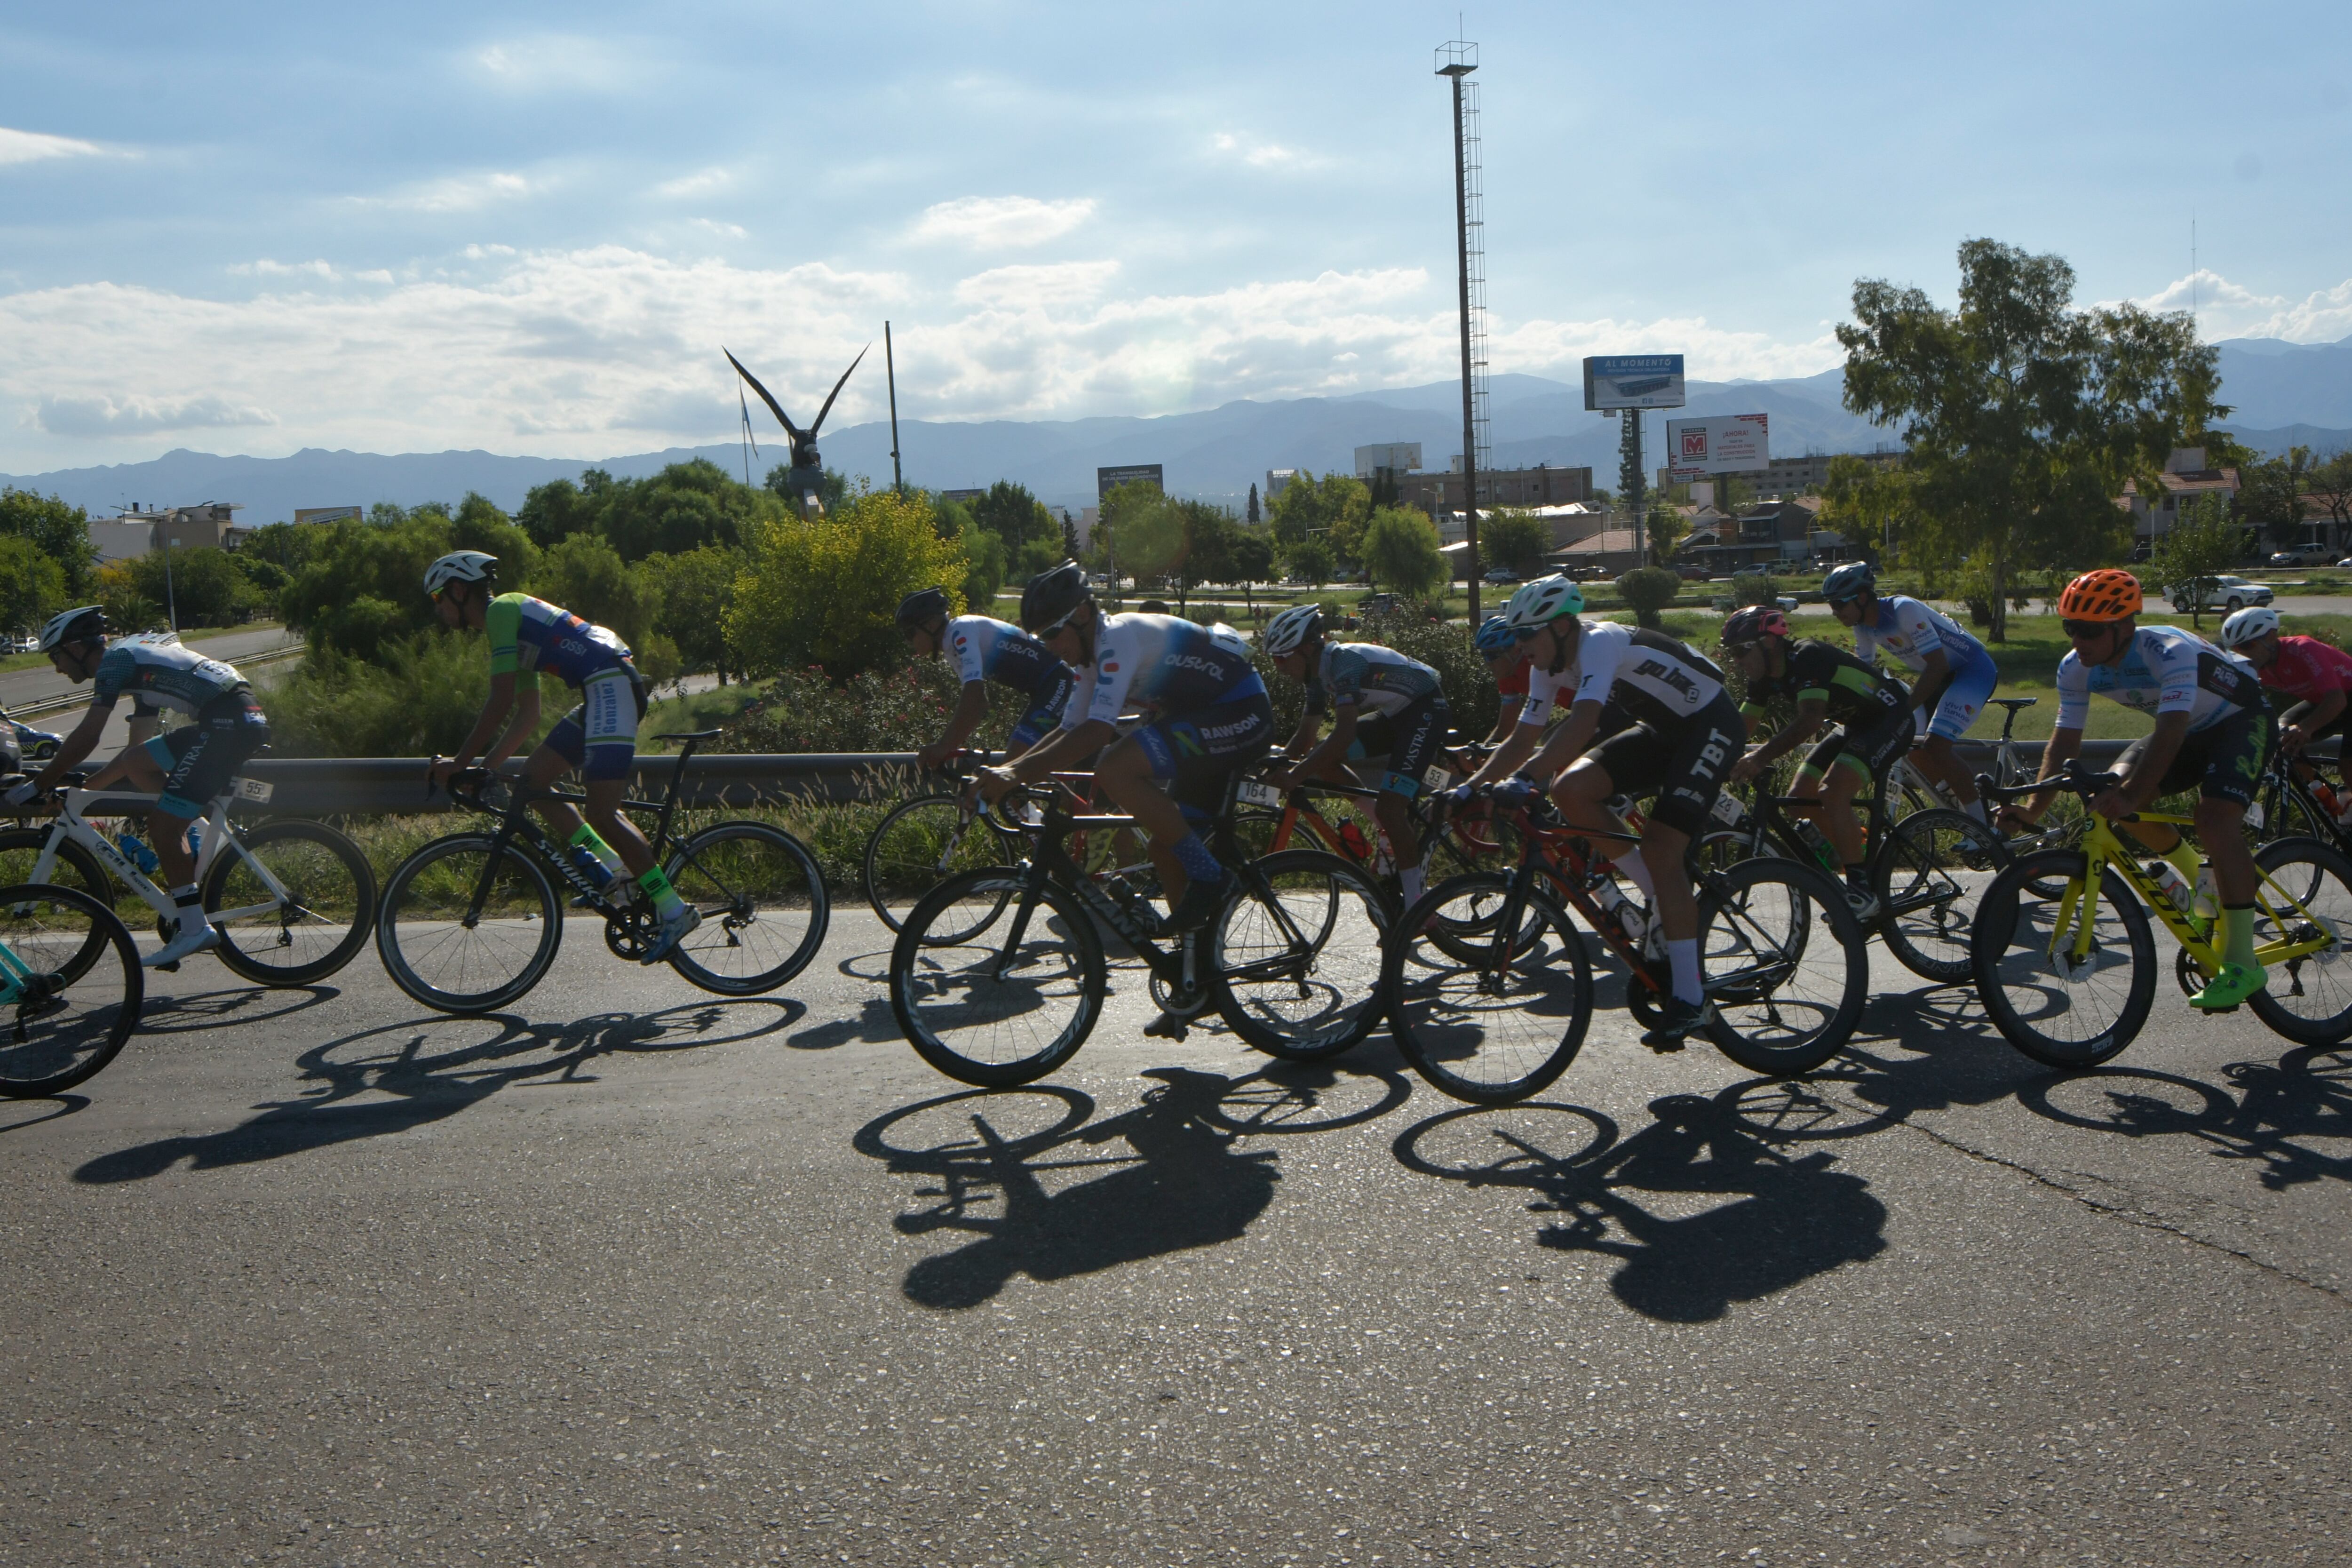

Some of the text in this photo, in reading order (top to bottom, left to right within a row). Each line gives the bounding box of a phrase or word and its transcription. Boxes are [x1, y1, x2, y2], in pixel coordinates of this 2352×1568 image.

[1621, 358, 1671, 367] MOMENTO
[1723, 430, 1748, 438] ¡AHORA!
[997, 640, 1039, 661] austral
[1939, 629, 1970, 652] Tunuyán
[1165, 654, 1224, 681] austral
[2213, 665, 2240, 688] PARIS
[1045, 679, 1067, 711] RAWSON
[1945, 701, 1963, 711] Vivi
[602, 682, 617, 733] Gonzalez
[1200, 713, 1261, 740] RAWSON
[1689, 727, 1733, 780] TBT
[1430, 770, 1441, 782] 53
[246, 782, 262, 794] 55
[1246, 783, 1267, 799] 164
[534, 839, 605, 907] S-WORKS
[2111, 850, 2211, 949] SCOTT
[1075, 879, 1150, 944] GIANT
